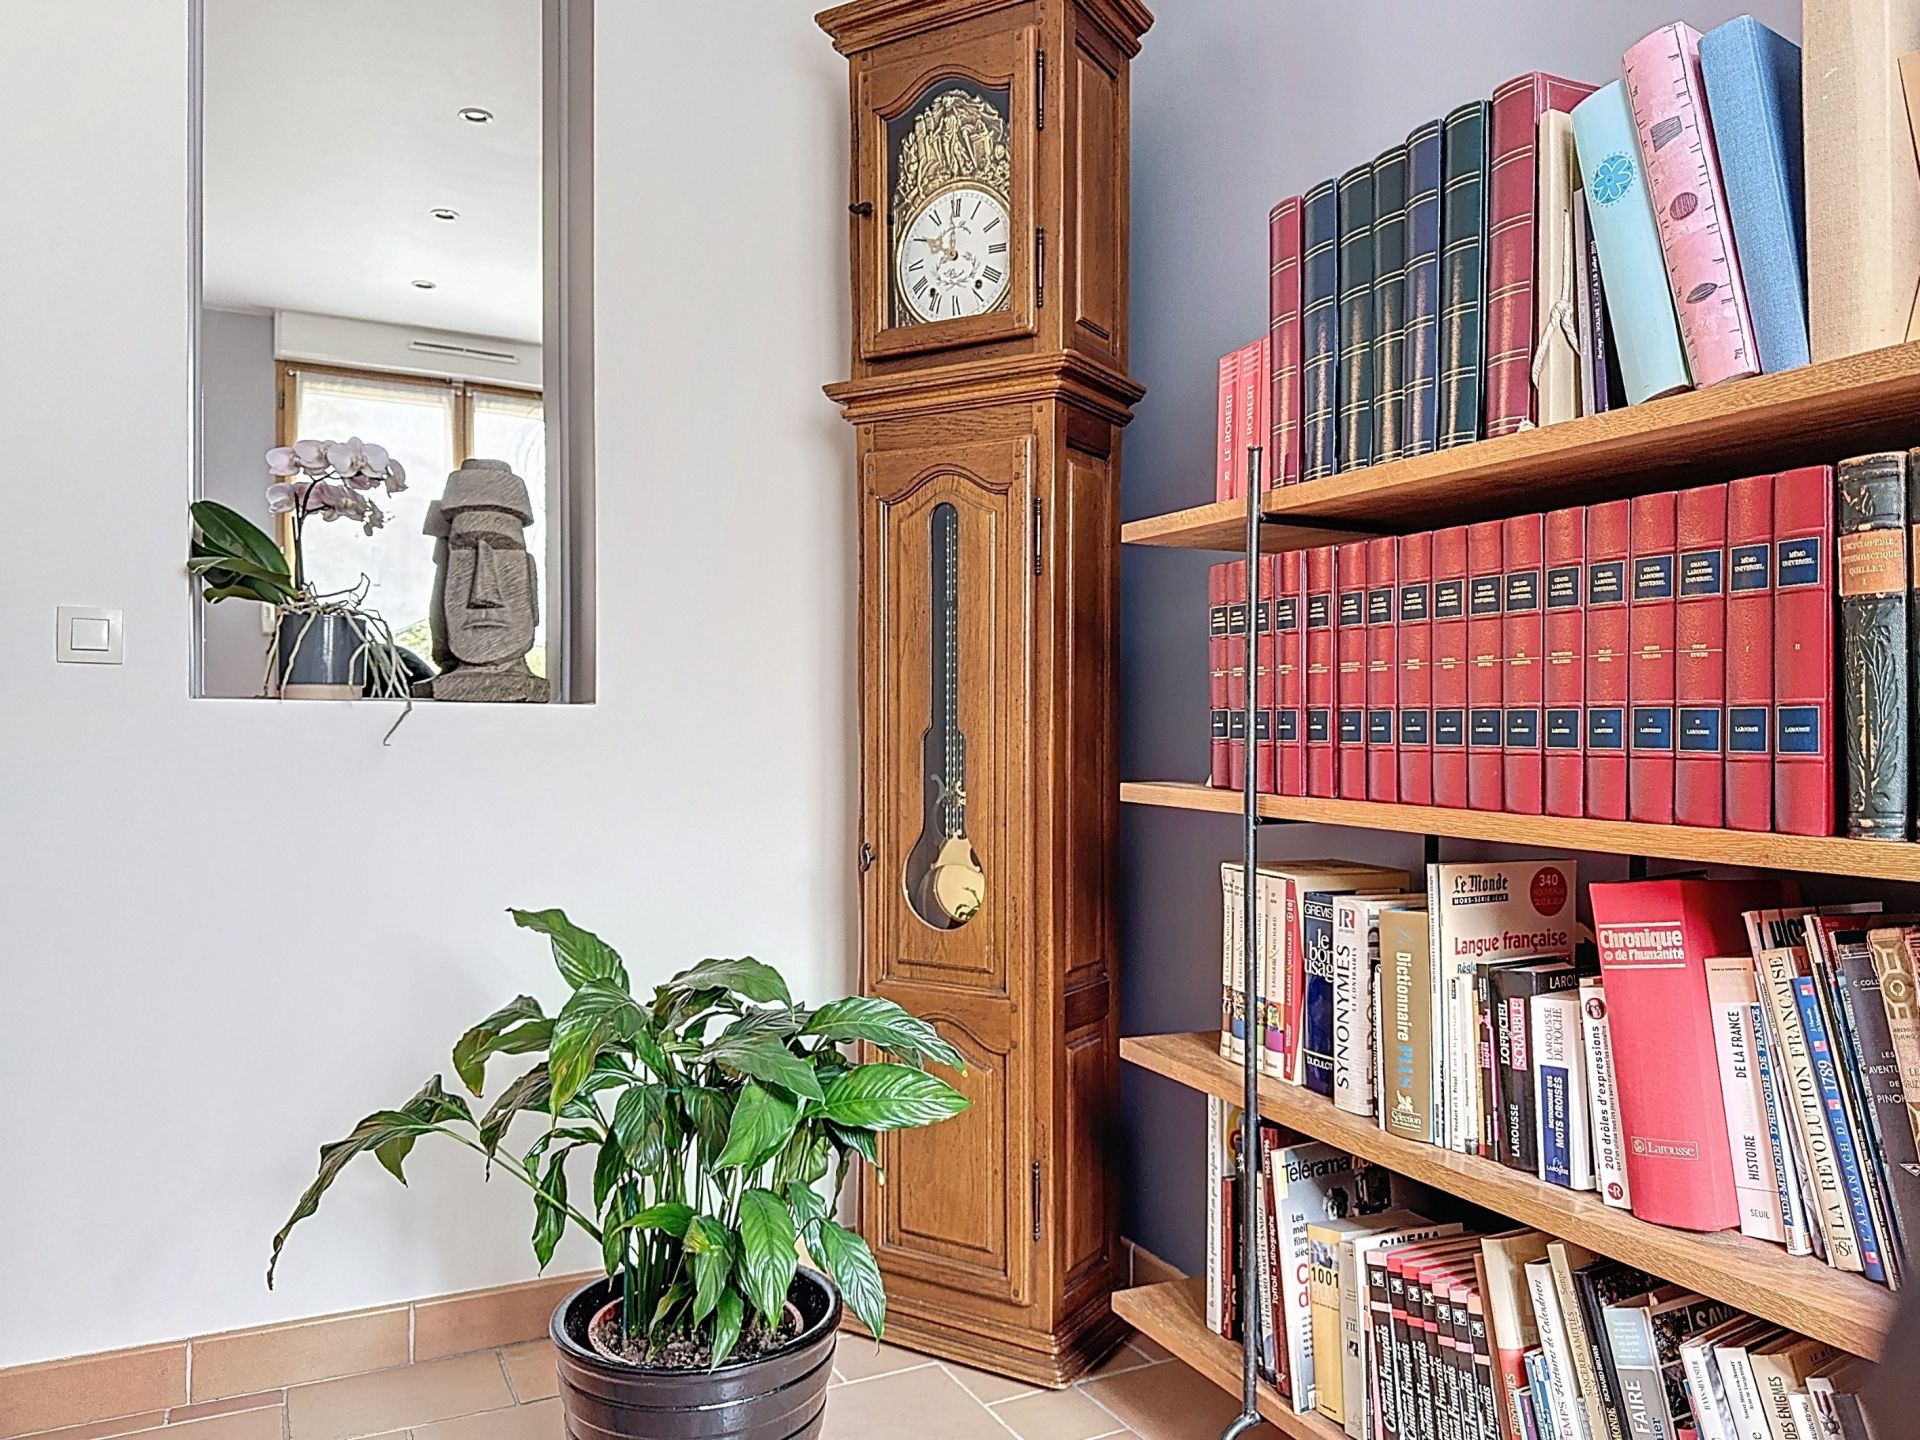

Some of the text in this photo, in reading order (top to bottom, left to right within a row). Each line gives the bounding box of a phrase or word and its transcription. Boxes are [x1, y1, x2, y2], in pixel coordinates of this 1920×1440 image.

[1223, 393, 1233, 462] LE ROBERT
[1246, 384, 1254, 435] ROBERT
[1849, 564, 1886, 576] QUILLET
[1453, 873, 1509, 895] Le Monde
[1539, 874, 1559, 886] 340
[1317, 928, 1329, 949] le
[1454, 928, 1567, 957] Langue française
[1600, 929, 1683, 953] Chronique
[1615, 948, 1684, 961] de l'humanité
[1335, 944, 1350, 1090] SYNONYMES
[1396, 952, 1413, 1041] Dictionnaire
[1769, 956, 1806, 1061] FRANÇAISE
[1511, 1001, 1526, 1066] SCRABBLE
[1544, 1007, 1553, 1060] LAROUSSE
[1552, 1007, 1563, 1061] DE POCHE
[1601, 1025, 1609, 1050] connaître
[1751, 1008, 1767, 1053] FRANCE
[1881, 1051, 1896, 1059] LES
[1307, 1056, 1333, 1071] DUCULOT
[1758, 1055, 1769, 1071] DE
[1818, 1059, 1837, 1094] 1789
[1889, 1080, 1900, 1088] DE
[1553, 1076, 1564, 1148] MOTS CROISÉS
[1590, 1025, 1614, 1170] 200 drôles d'expressions
[1608, 1097, 1616, 1111] jours
[1727, 1011, 1760, 1181] HISTOIRE DE LA FRANCE
[1761, 1073, 1779, 1136] D'HISTOIRE
[1877, 1094, 1906, 1104] PINO
[1509, 1104, 1520, 1157] LAROUSSE
[1647, 1141, 1695, 1157] Larousse
[1794, 1065, 1837, 1193] RÉVOLUTION
[1833, 1116, 1846, 1137] DE
[1282, 1156, 1350, 1184] Télérama
[1771, 1138, 1793, 1222] AIDE-MEMOIRE
[1840, 1142, 1872, 1242] L'ALMANACH
[1258, 1206, 1266, 1243] SANDOZ
[1291, 1214, 1304, 1223] Les
[1750, 1208, 1770, 1220] SEUIL
[1828, 1203, 1846, 1231] LA
[1260, 1245, 1268, 1276] MARCEL
[1268, 1215, 1278, 1266] Lithographe
[1269, 1275, 1279, 1304] Toffoli
[1311, 1266, 1340, 1288] 1001
[1561, 1269, 1569, 1295] Sempé
[1379, 1324, 1394, 1387] Français
[1534, 1279, 1565, 1396] Histoires de Calendriers
[1400, 1342, 1414, 1396] Français
[1416, 1340, 1430, 1395] Français
[1434, 1356, 1448, 1409] Français
[1448, 1364, 1461, 1417] Français
[1591, 1344, 1611, 1402] RICHARD BROWN
[1383, 1385, 1397, 1433] Cinéma
[1463, 1371, 1478, 1422] Français
[1479, 1385, 1495, 1440] Français
[1624, 1379, 1651, 1435] FAIRE
[1768, 1376, 1799, 1440] DES ÉNIGMES
